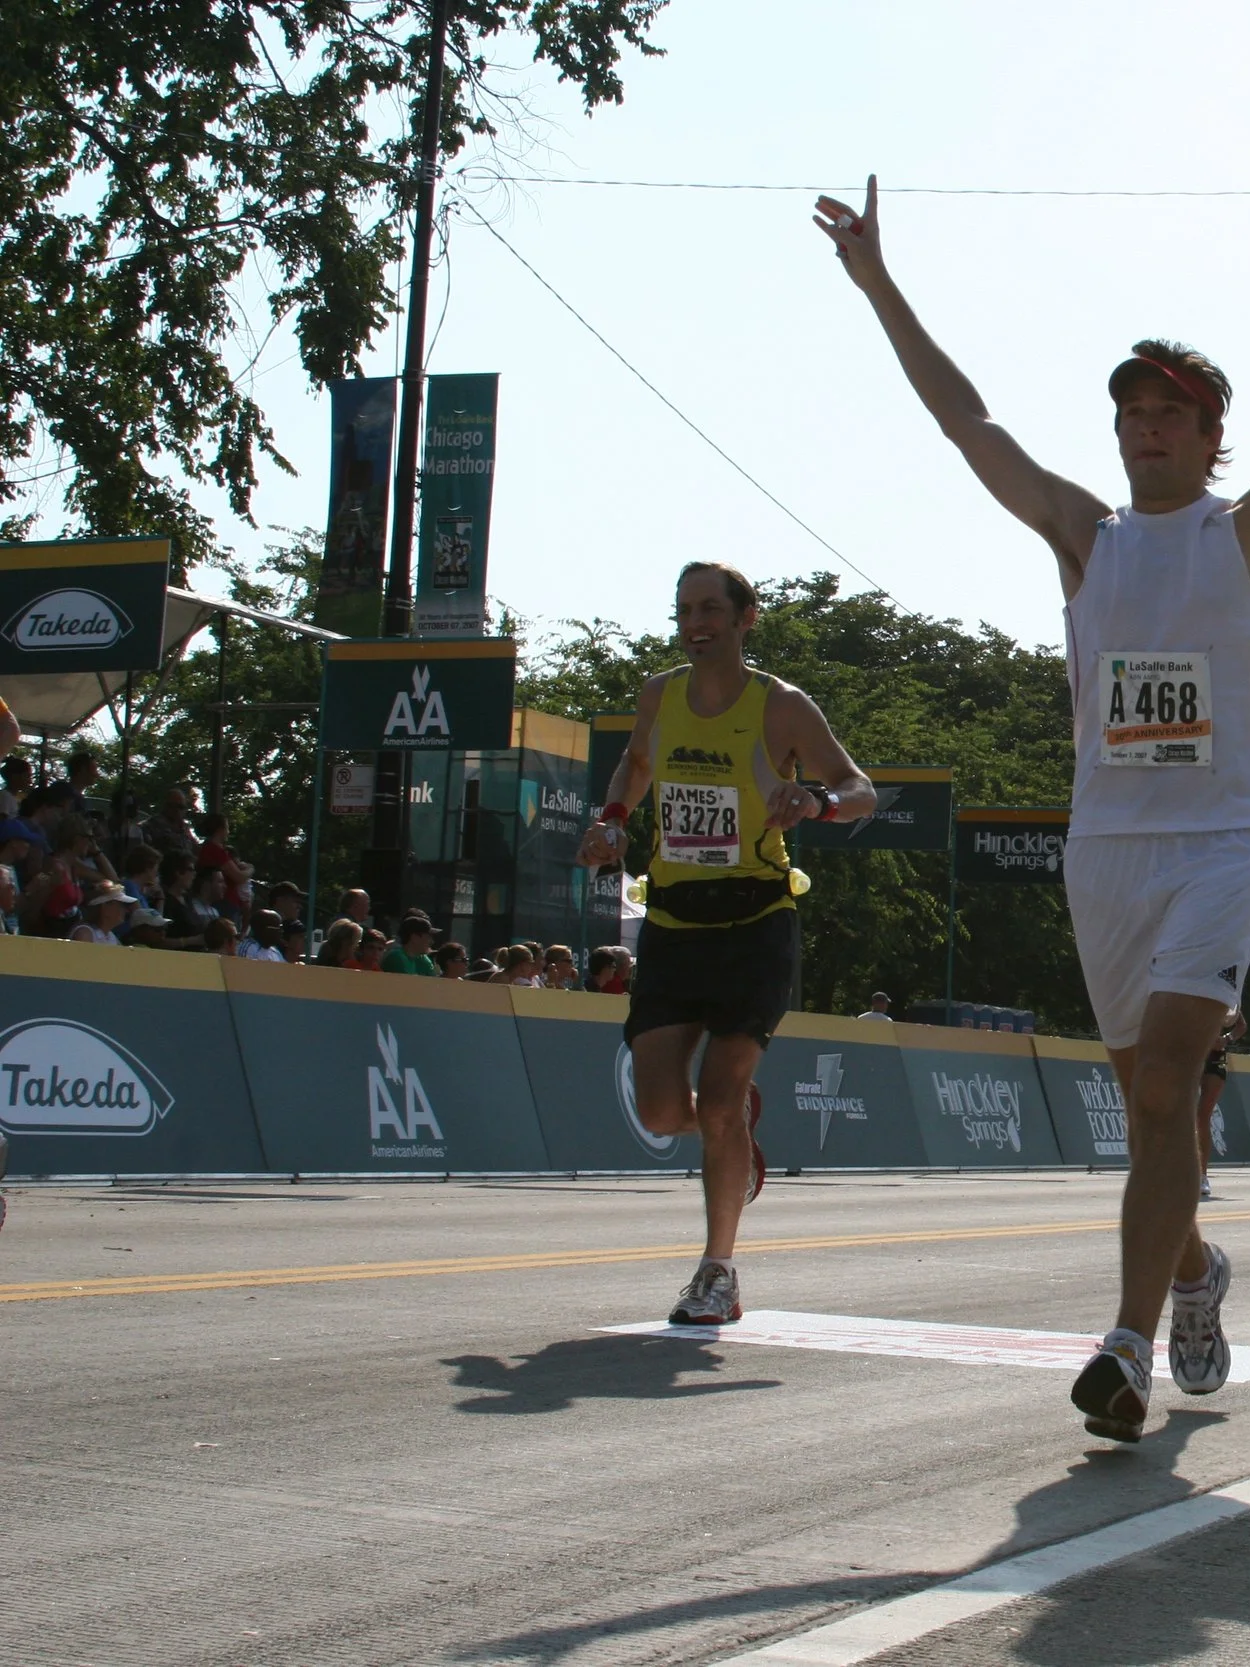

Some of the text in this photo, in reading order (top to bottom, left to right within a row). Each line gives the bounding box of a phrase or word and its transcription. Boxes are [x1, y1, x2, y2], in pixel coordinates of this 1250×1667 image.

[426, 427, 483, 451] Chicago
[425, 455, 495, 475] Marathon
[27, 612, 112, 637] Takeda
[1129, 661, 1193, 672] LaSalle Bank
[383, 691, 450, 735] AA
[1110, 681, 1197, 724] A 468
[1134, 725, 1204, 739] ANNIVERSARY
[541, 786, 583, 815] LaSalle
[665, 786, 717, 805] JAMES
[541, 818, 555, 831] ABN
[661, 802, 736, 837] B 3278
[872, 811, 915, 820] RANCE
[996, 853, 1045, 871] Springs
[594, 876, 621, 898] LaSa
[2, 1063, 141, 1110] Takeda
[1075, 1080, 1126, 1110] WHOLE
[368, 1066, 445, 1140] AA
[796, 1096, 867, 1112] ENDURANCE
[931, 1071, 1022, 1131] Hinckley
[962, 1116, 1009, 1150] Springs
[372, 1145, 445, 1158] AmericanAirlines
